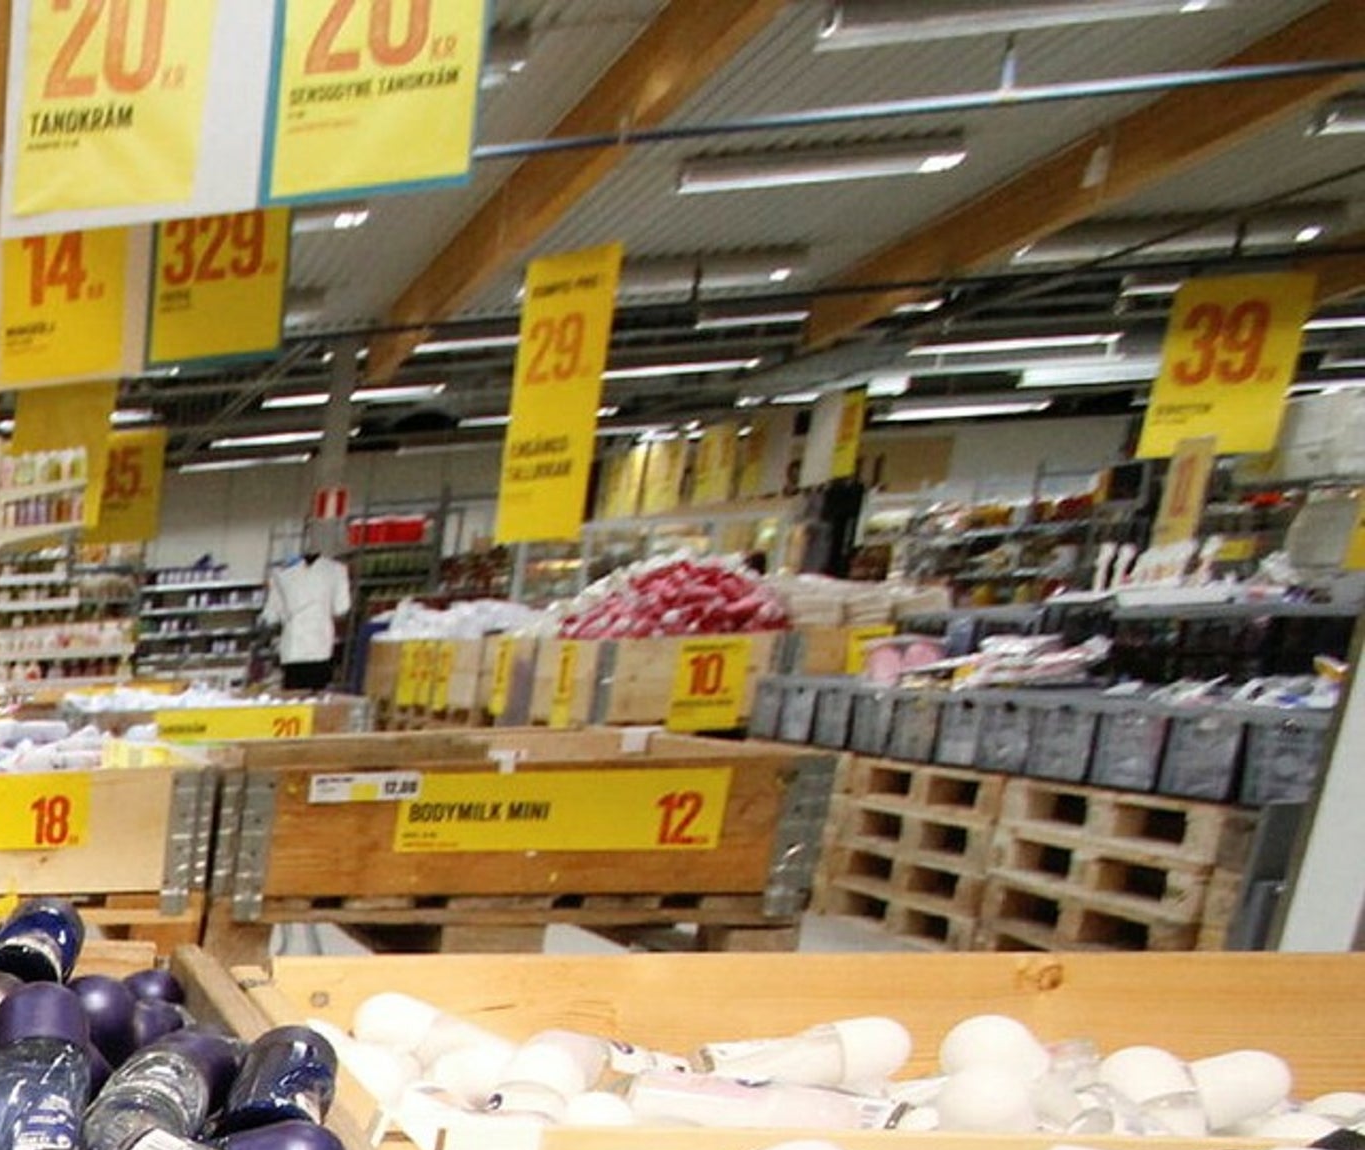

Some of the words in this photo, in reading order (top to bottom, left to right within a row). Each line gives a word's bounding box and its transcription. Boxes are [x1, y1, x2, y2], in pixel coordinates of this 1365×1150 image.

[43, 0, 167, 99] 20
[29, 103, 133, 137] TANDKRÄM
[22, 230, 86, 307] 14
[163, 211, 267, 286] 329
[524, 312, 586, 386] 29
[1173, 298, 1271, 386] 39
[690, 652, 725, 696] 10
[30, 795, 71, 846] 18
[408, 801, 502, 823] BODYMILK
[506, 800, 551, 821] MINI
[656, 790, 699, 845] 12
